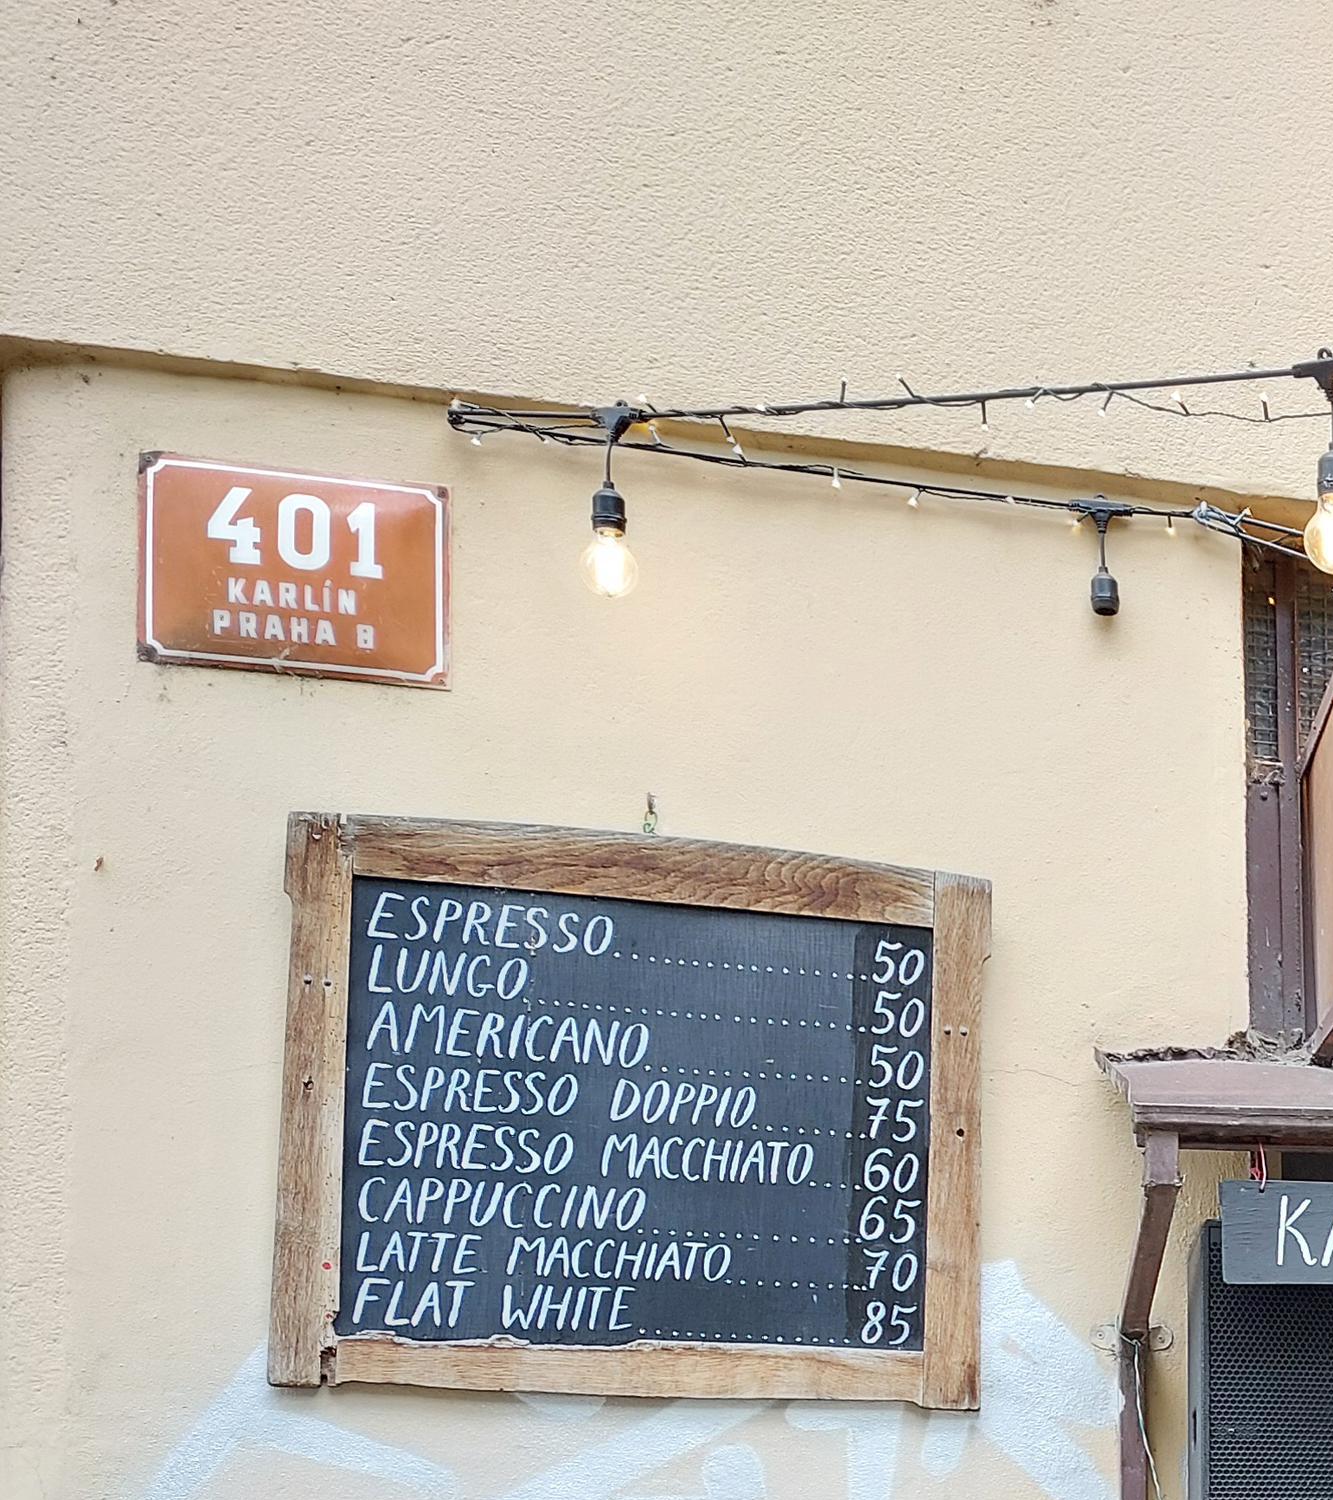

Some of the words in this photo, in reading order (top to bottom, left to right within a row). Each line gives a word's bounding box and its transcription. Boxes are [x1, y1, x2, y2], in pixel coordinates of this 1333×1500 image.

[207, 486, 384, 580] 401
[212, 609, 338, 647] PRAHA
[356, 624, 375, 651] 8
[227, 577, 357, 616] KARLÍN
[367, 891, 614, 957] ESPRESSO
[871, 940, 925, 986] 50
[367, 945, 529, 1002] LUNGO
[869, 991, 925, 1039] 50
[366, 1001, 650, 1070] AMERICANO
[867, 1045, 924, 1091] 50
[362, 1062, 579, 1117] ESPRESSO
[609, 1076, 757, 1129] DOPPIO
[865, 1096, 924, 1143] 75
[357, 1119, 574, 1176] ESPRESSO
[600, 1132, 815, 1186] MACCHIATO
[861, 1149, 920, 1195] 60
[357, 1176, 647, 1233] CAPPUCCINO
[858, 1200, 922, 1245] 65
[355, 1232, 482, 1275] LATTE
[506, 1236, 732, 1282] MACCHIATO
[863, 1250, 919, 1292] 70
[352, 1278, 479, 1329] FLAT
[499, 1286, 637, 1331] WHITE
[859, 1302, 918, 1347] 85
